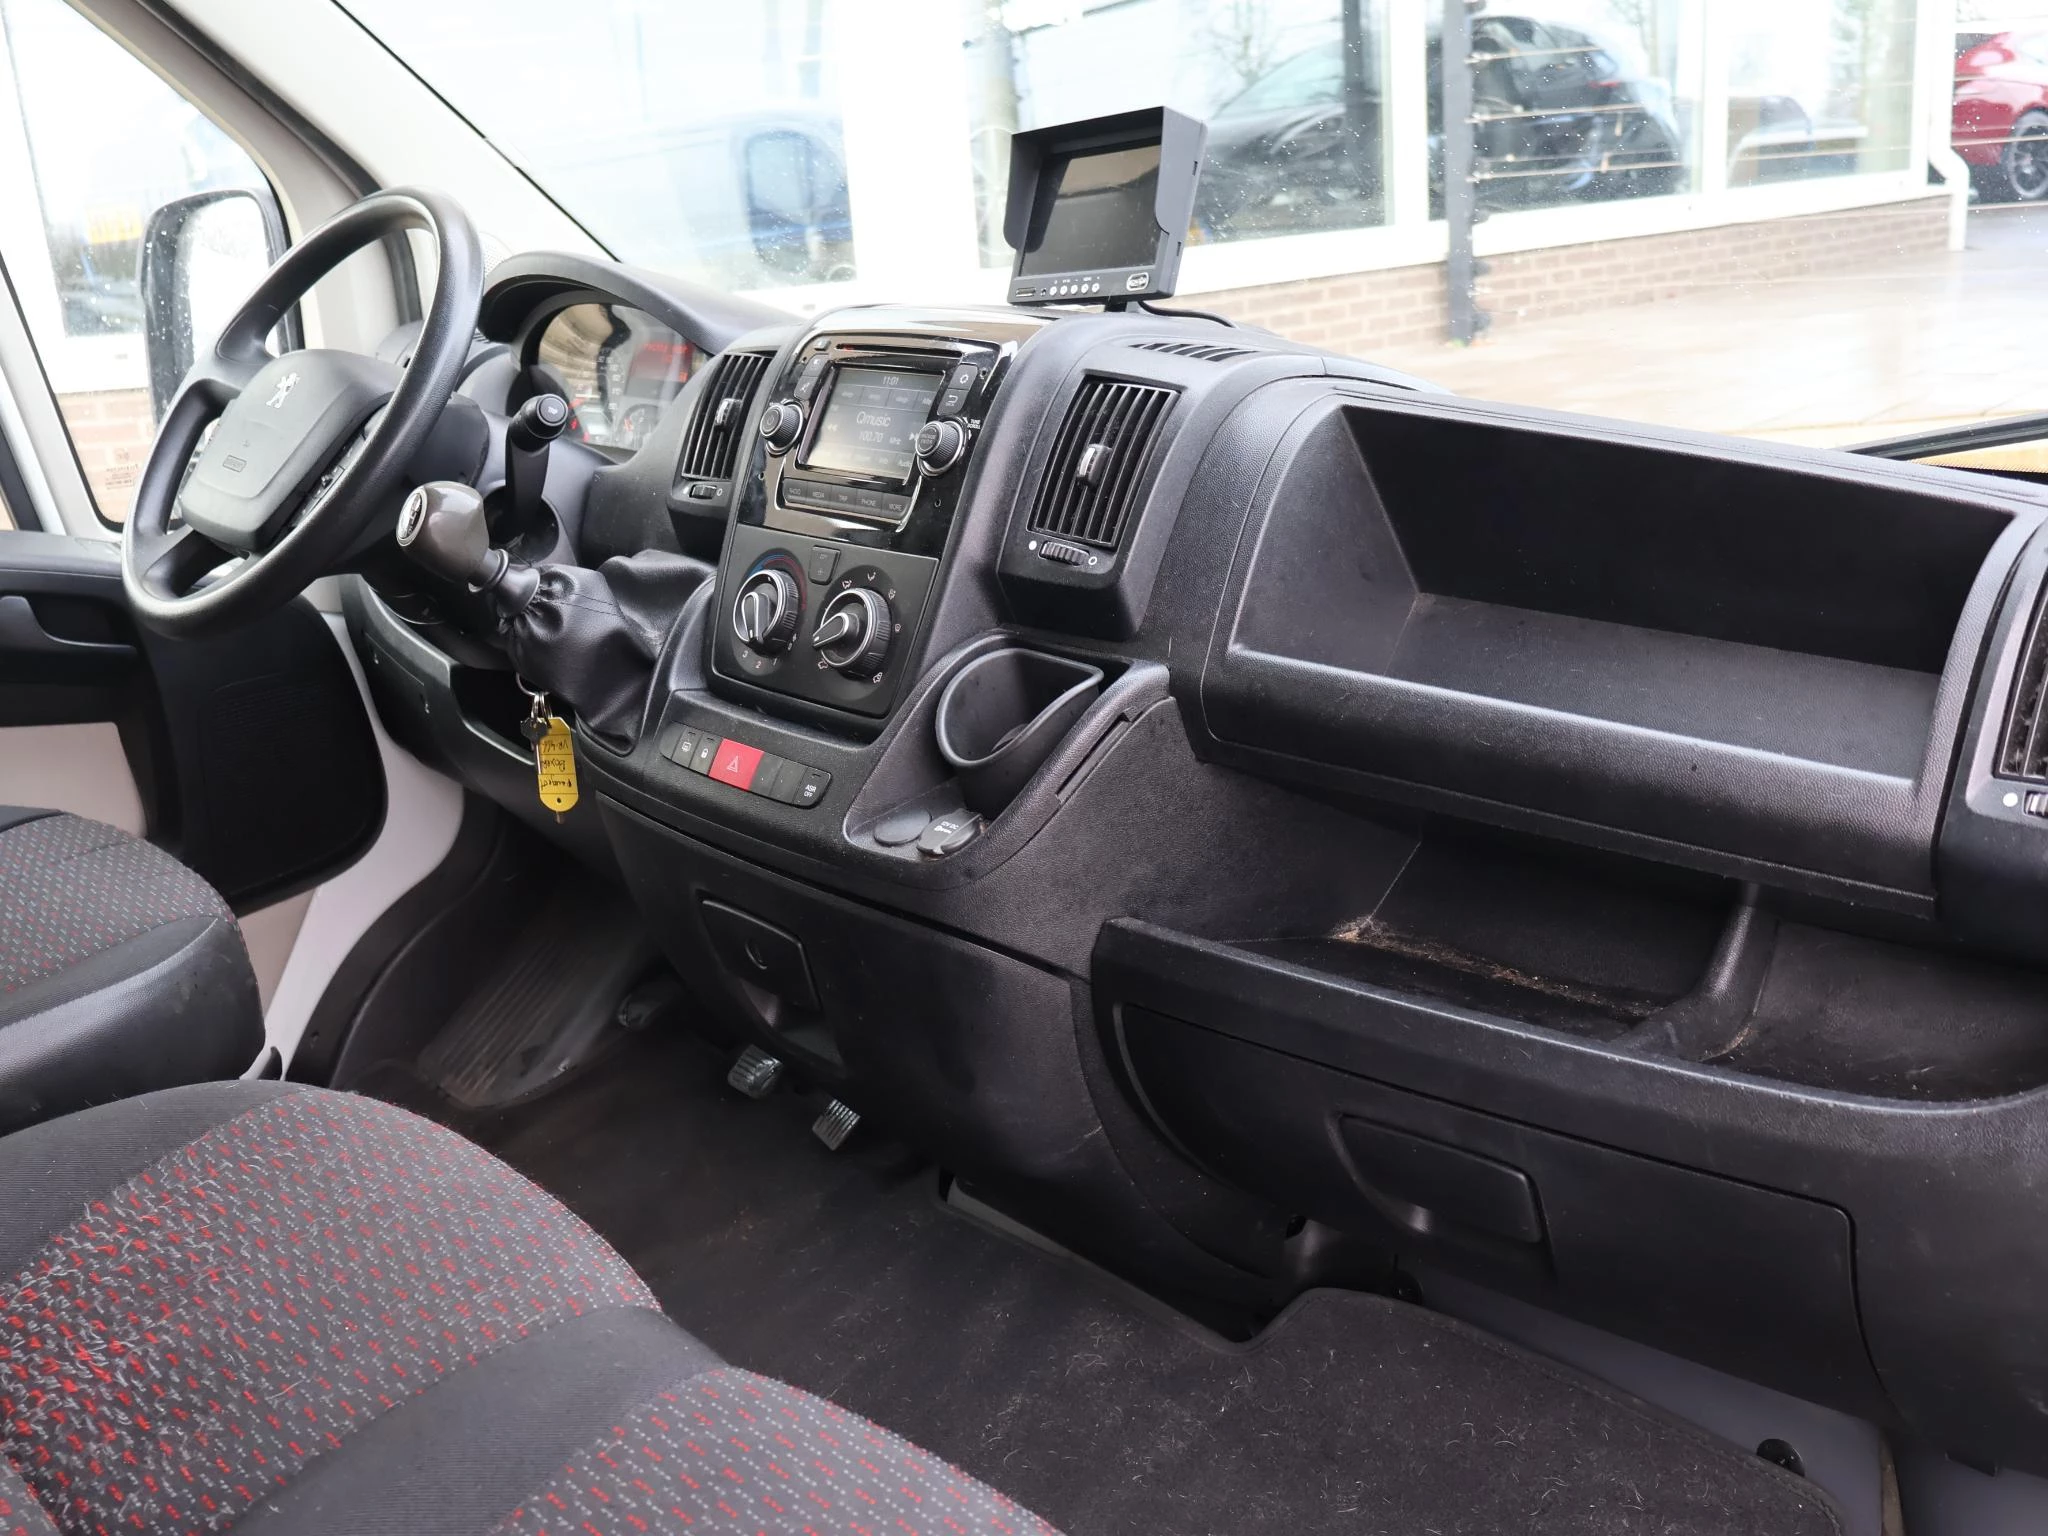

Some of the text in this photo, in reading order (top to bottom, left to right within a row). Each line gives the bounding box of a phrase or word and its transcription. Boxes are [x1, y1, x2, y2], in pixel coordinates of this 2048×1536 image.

[882, 375, 900, 385] 11:01
[856, 411, 891, 427] Qmusic
[755, 660, 762, 669] 2
[804, 784, 817, 793] ASR
[803, 790, 814, 798] OFF
